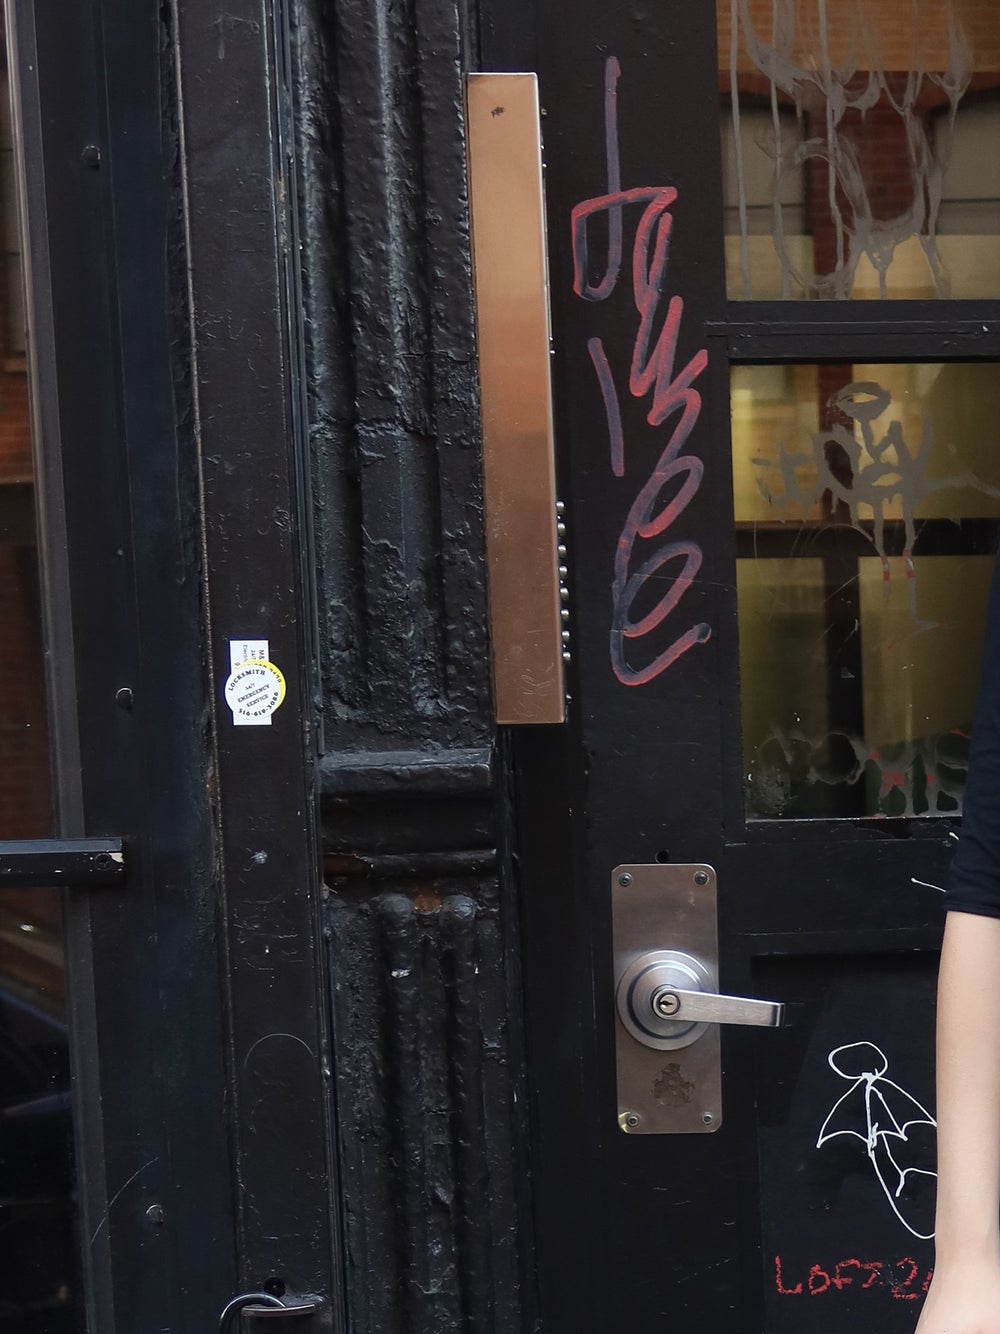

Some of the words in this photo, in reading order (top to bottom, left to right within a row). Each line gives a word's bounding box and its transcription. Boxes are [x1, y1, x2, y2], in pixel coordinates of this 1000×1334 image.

[228, 668, 267, 692] LOCKSMITH
[237, 684, 270, 703] EMERGENCY
[246, 694, 270, 708] SERVICE
